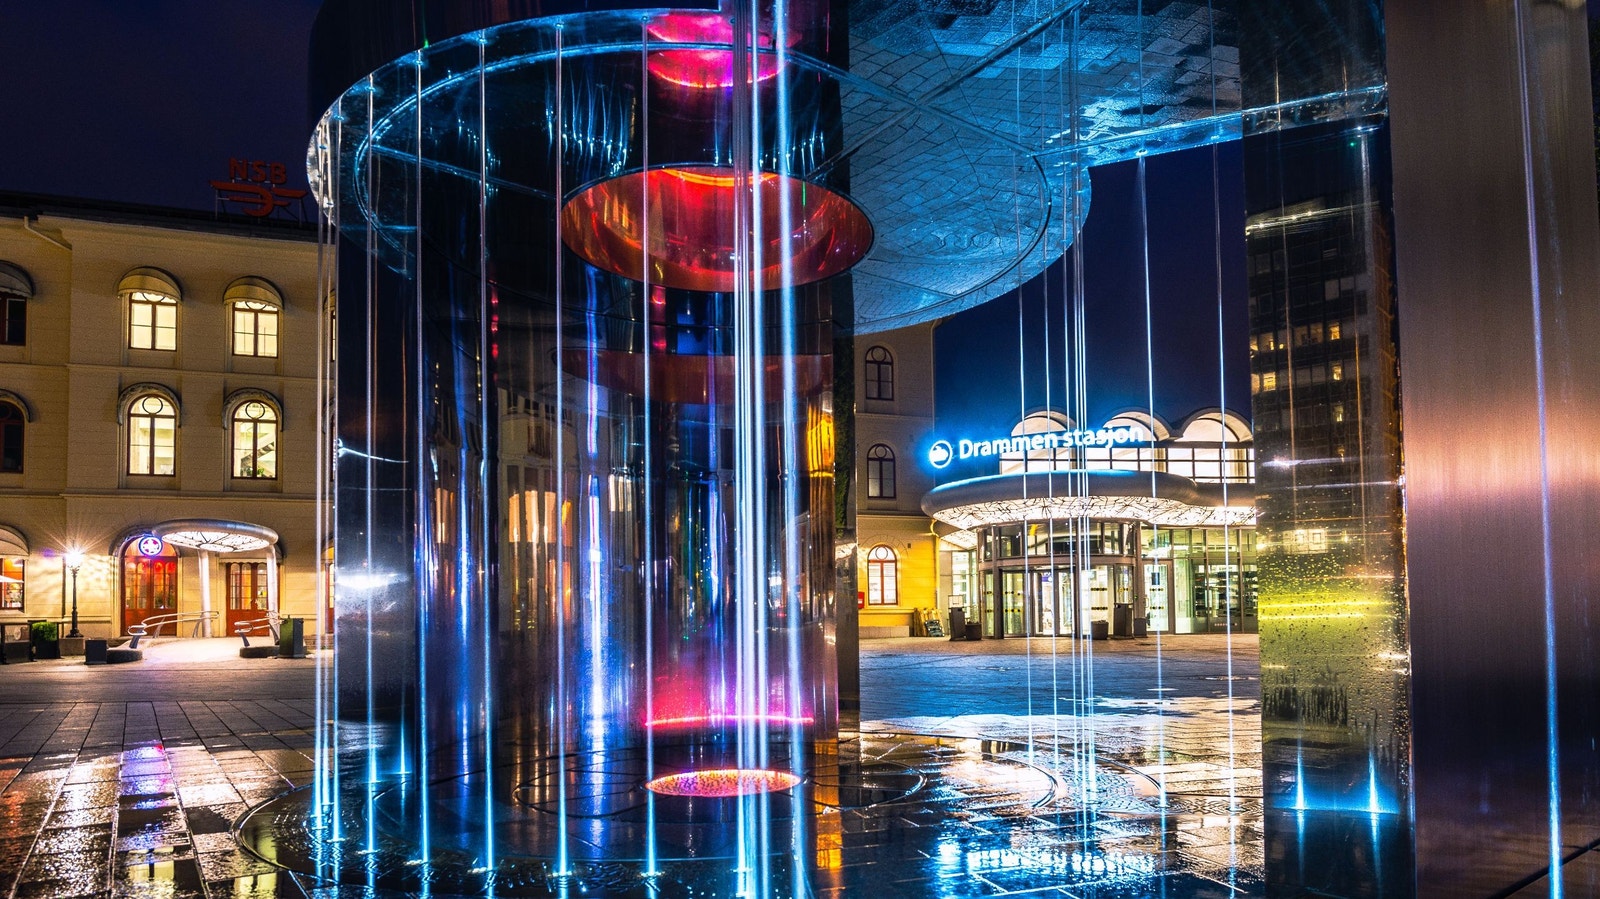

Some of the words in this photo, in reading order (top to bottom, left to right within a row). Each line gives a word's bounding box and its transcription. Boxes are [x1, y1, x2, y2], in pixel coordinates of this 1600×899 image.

[229, 157, 287, 184] NSB
[959, 433, 1058, 459] Drammen
[1063, 426, 1144, 449] stasjon
